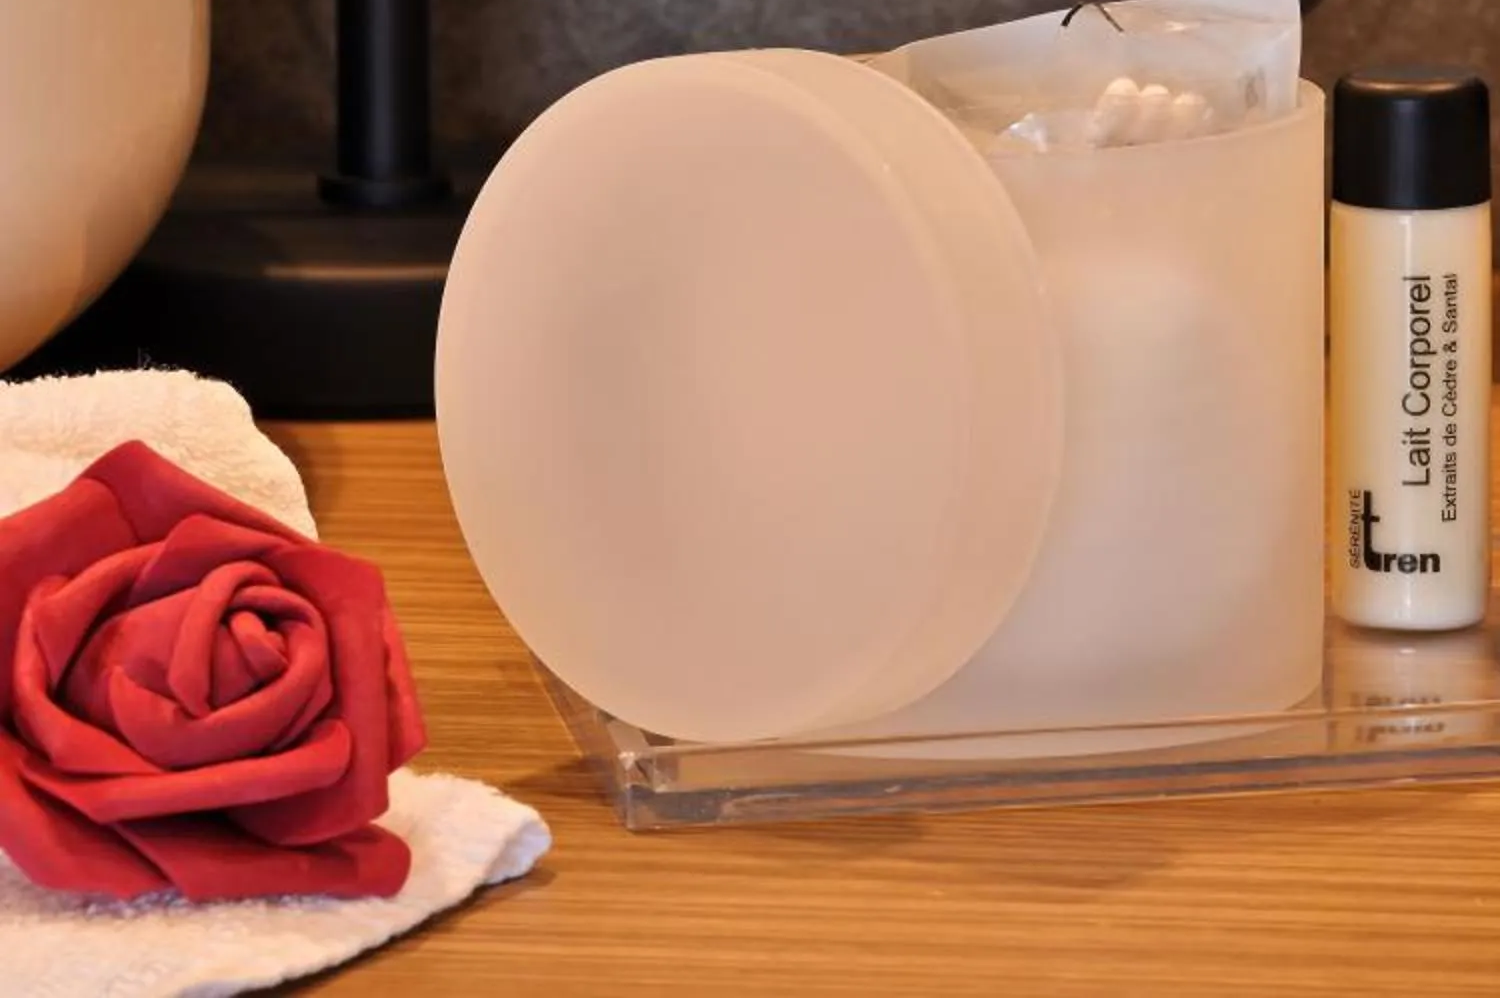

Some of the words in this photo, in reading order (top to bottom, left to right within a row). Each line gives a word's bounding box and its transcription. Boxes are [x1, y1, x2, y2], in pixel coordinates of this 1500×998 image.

[1441, 273, 1458, 334] Santal
[1400, 274, 1437, 417] Corporel
[1441, 340, 1457, 354] &
[1441, 359, 1457, 417] Cèdre
[1401, 427, 1431, 487] Lait
[1441, 423, 1457, 447] de
[1441, 451, 1457, 522] Extraits
